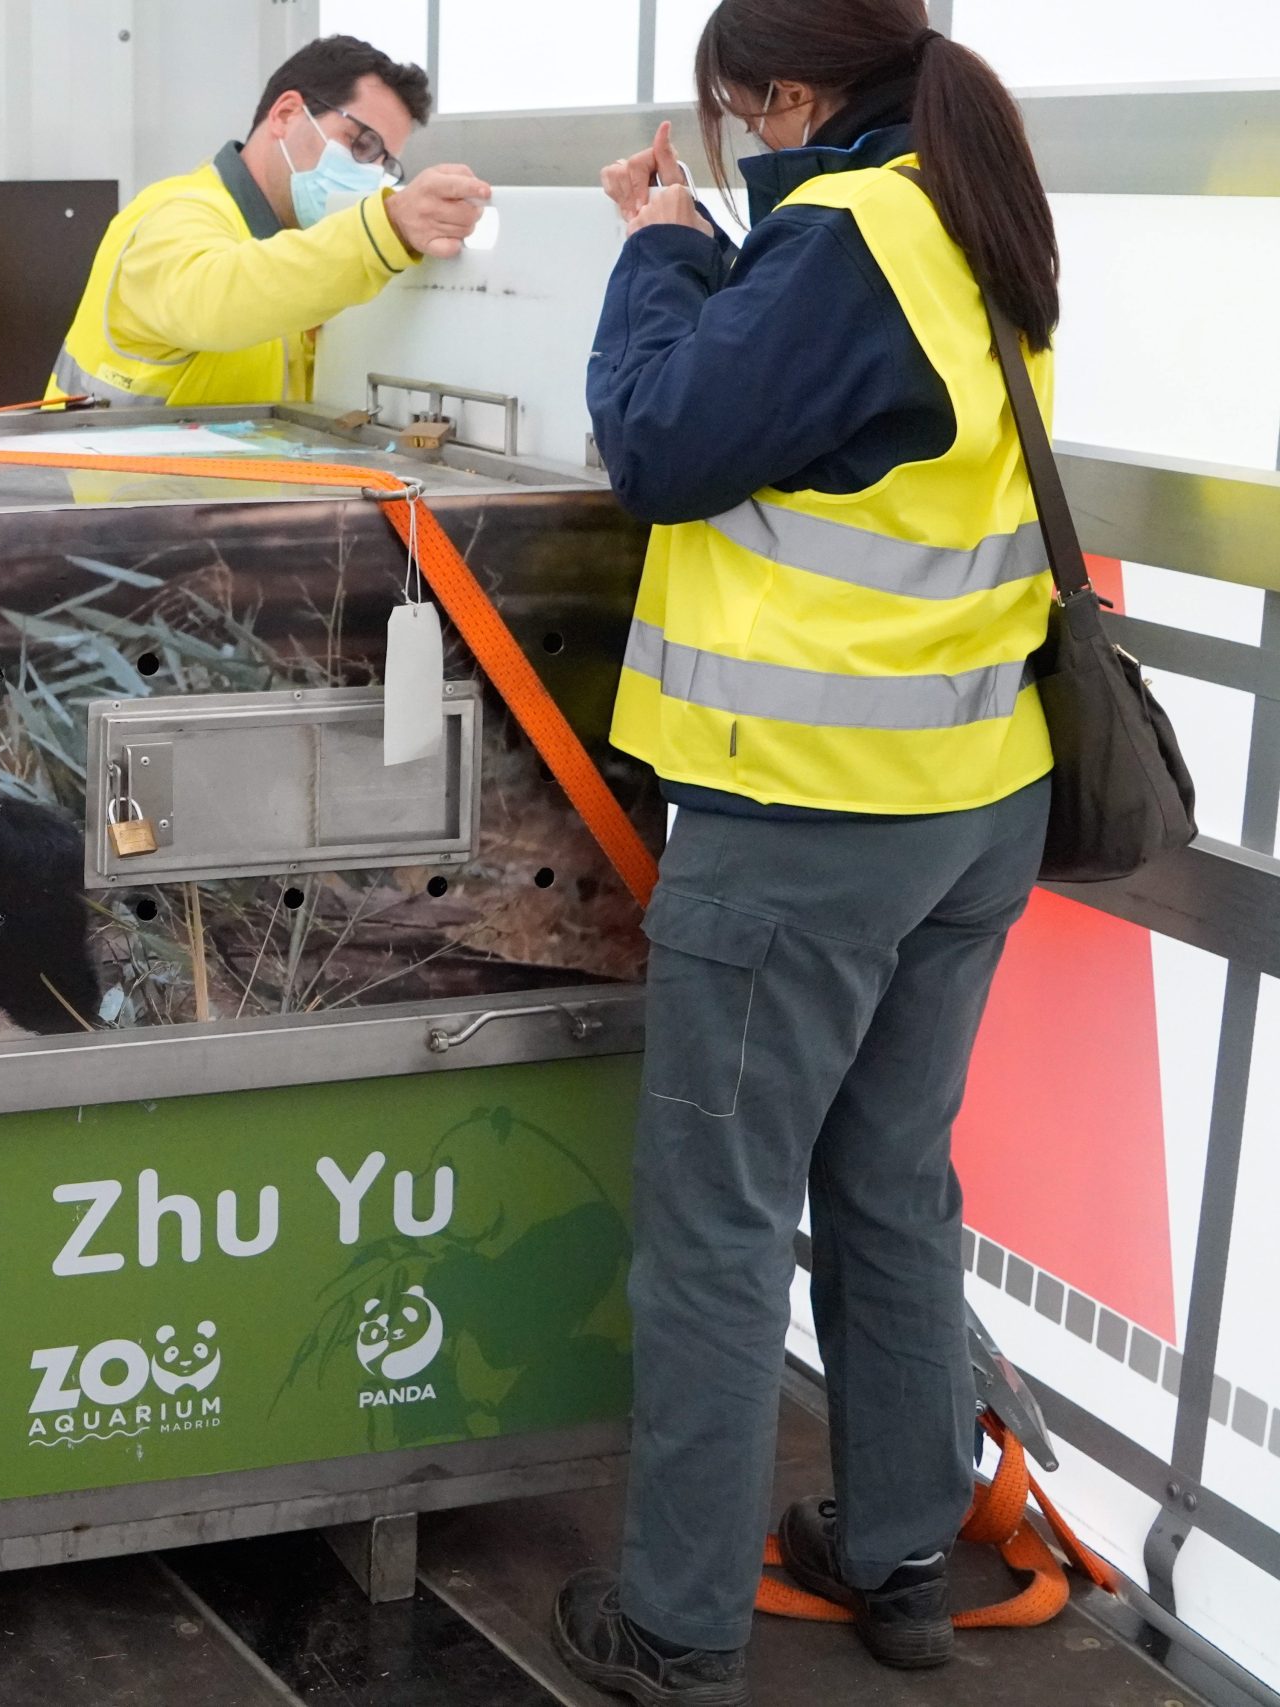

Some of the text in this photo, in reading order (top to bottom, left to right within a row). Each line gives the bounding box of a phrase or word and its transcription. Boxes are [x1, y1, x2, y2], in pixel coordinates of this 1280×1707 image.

[52, 1168, 280, 1277] Zhu
[316, 1150, 454, 1246] Yu
[358, 1383, 437, 1409] PANDA
[28, 1396, 221, 1437] AQUARIUM
[160, 1417, 221, 1433] MADRID
